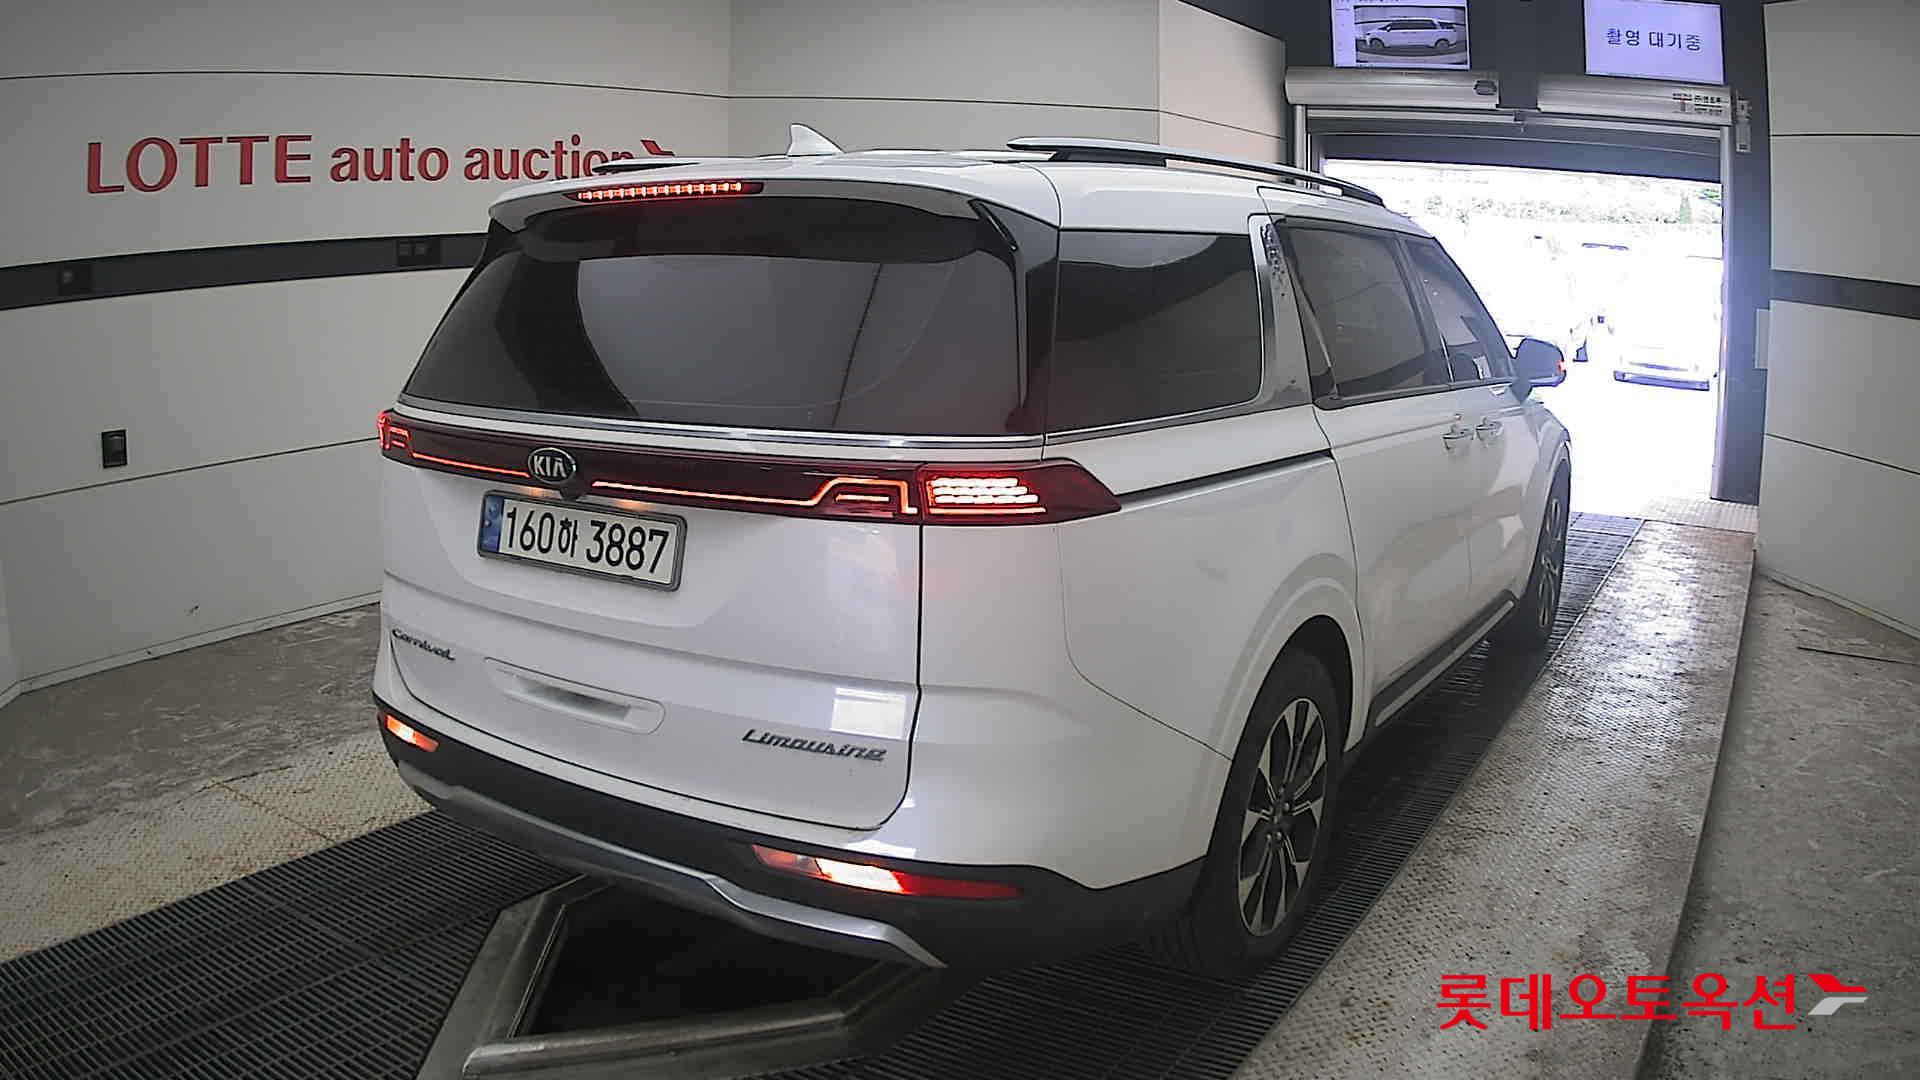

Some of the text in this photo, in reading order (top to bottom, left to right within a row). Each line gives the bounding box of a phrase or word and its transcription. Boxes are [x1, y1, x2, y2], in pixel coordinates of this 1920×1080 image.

[1648, 31, 1701, 52] 대기중
[86, 135, 312, 194] LOTTE
[329, 137, 449, 183] auto
[533, 454, 568, 478] KIA
[506, 507, 670, 574] 160하 3887
[742, 729, 887, 761] Limousine
